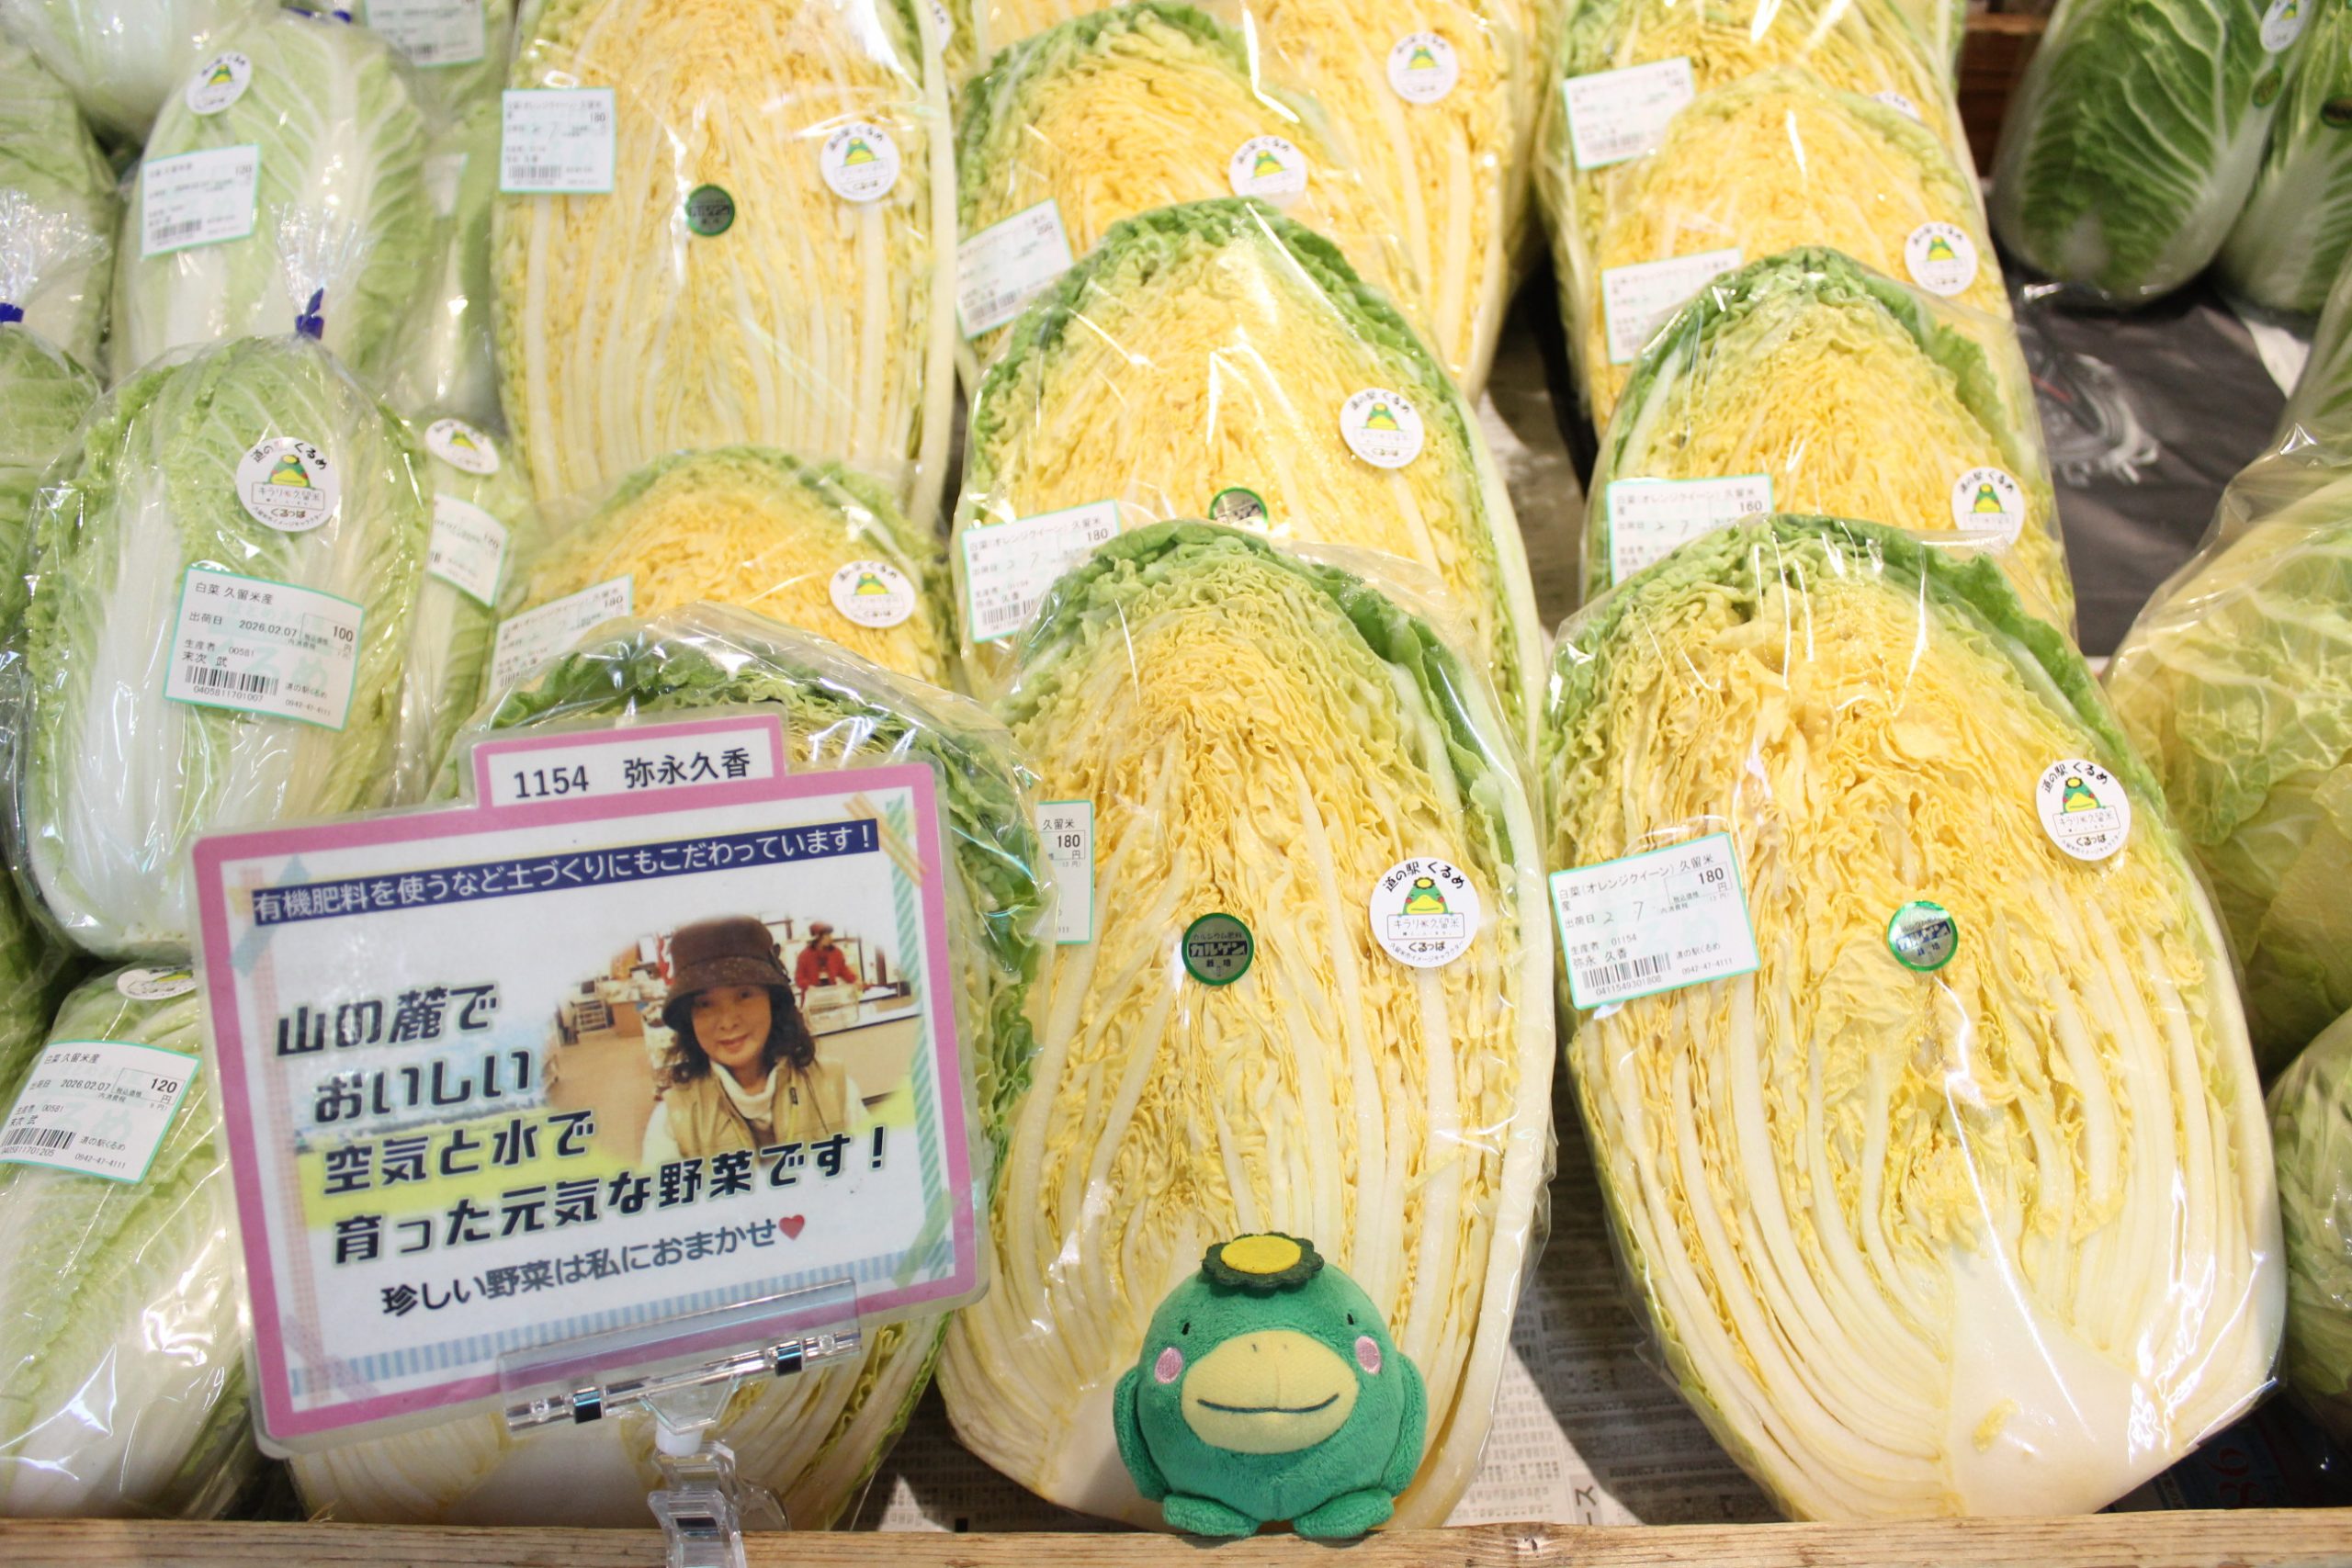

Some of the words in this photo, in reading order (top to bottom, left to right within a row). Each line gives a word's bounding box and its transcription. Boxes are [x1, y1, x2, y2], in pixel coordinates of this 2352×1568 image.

[294, 443, 327, 470] くるめ
[1087, 528, 1109, 542] 180
[195, 581, 221, 595] 白菜
[224, 587, 274, 605] 久留米産
[188, 612, 222, 626] 出荷日
[238, 619, 298, 637] 2026.02.07
[333, 626, 354, 642] 100
[229, 647, 254, 658] 00581
[513, 765, 590, 798] 1154
[623, 747, 751, 789] 弥永久香
[2041, 763, 2068, 794] 道の駅
[2073, 761, 2108, 784] くるめ
[1043, 818, 1075, 831] 久留米
[1057, 834, 1080, 848] 180
[1072, 850, 1080, 860] 円
[1679, 853, 1714, 873] 久留米
[254, 824, 872, 922] 有機肥料を使うなど土づくりにもこだわっています！
[1383, 861, 1421, 893] 道の駅
[1428, 861, 1464, 889] くるめ
[1699, 867, 1724, 886] 180
[1717, 882, 1728, 893] 円
[1565, 914, 1596, 929] 出荷日
[1602, 912, 1614, 925] 2
[1633, 901, 1644, 921] 7
[1611, 933, 1637, 947] 01154
[1189, 942, 1246, 957] カルゲン
[276, 983, 498, 1057] 山の麓で
[60, 1078, 110, 1091] 2026.02.07
[150, 1077, 177, 1094] 120
[314, 1050, 530, 1123] おいしい
[161, 1094, 172, 1103] 円
[41, 1104, 64, 1112] 00581
[80, 1135, 126, 1151] 道の駅くるめ
[323, 1109, 595, 1195] 空気と水で
[334, 1125, 887, 1265] 育った元気な野菜です！
[380, 1217, 777, 1317] 珍しい野菜は私におまかせ
